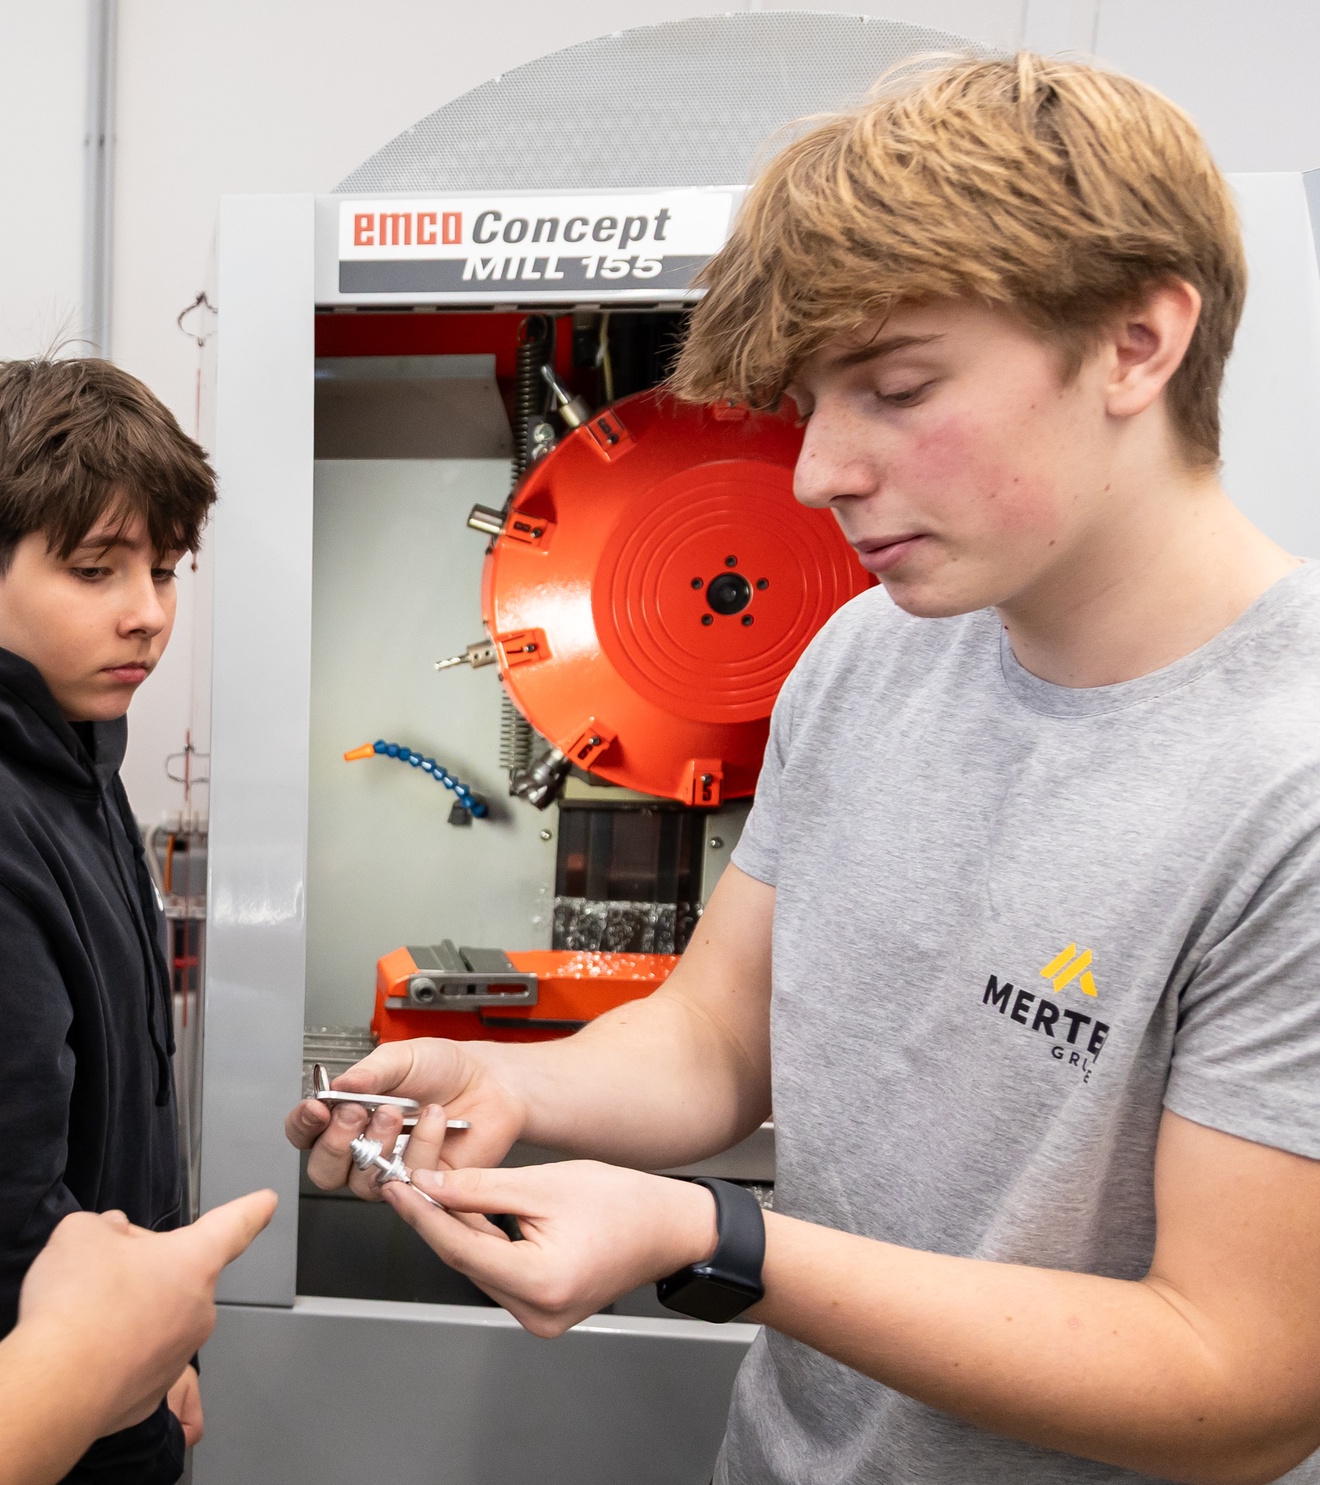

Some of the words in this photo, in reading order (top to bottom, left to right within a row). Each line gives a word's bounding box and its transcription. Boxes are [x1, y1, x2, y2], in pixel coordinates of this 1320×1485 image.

[472, 207, 672, 250] Concept
[462, 254, 565, 281] MILL
[581, 253, 664, 280] 155
[513, 520, 532, 533] 8
[702, 783, 712, 801] 5
[982, 974, 1110, 1060] MERTE
